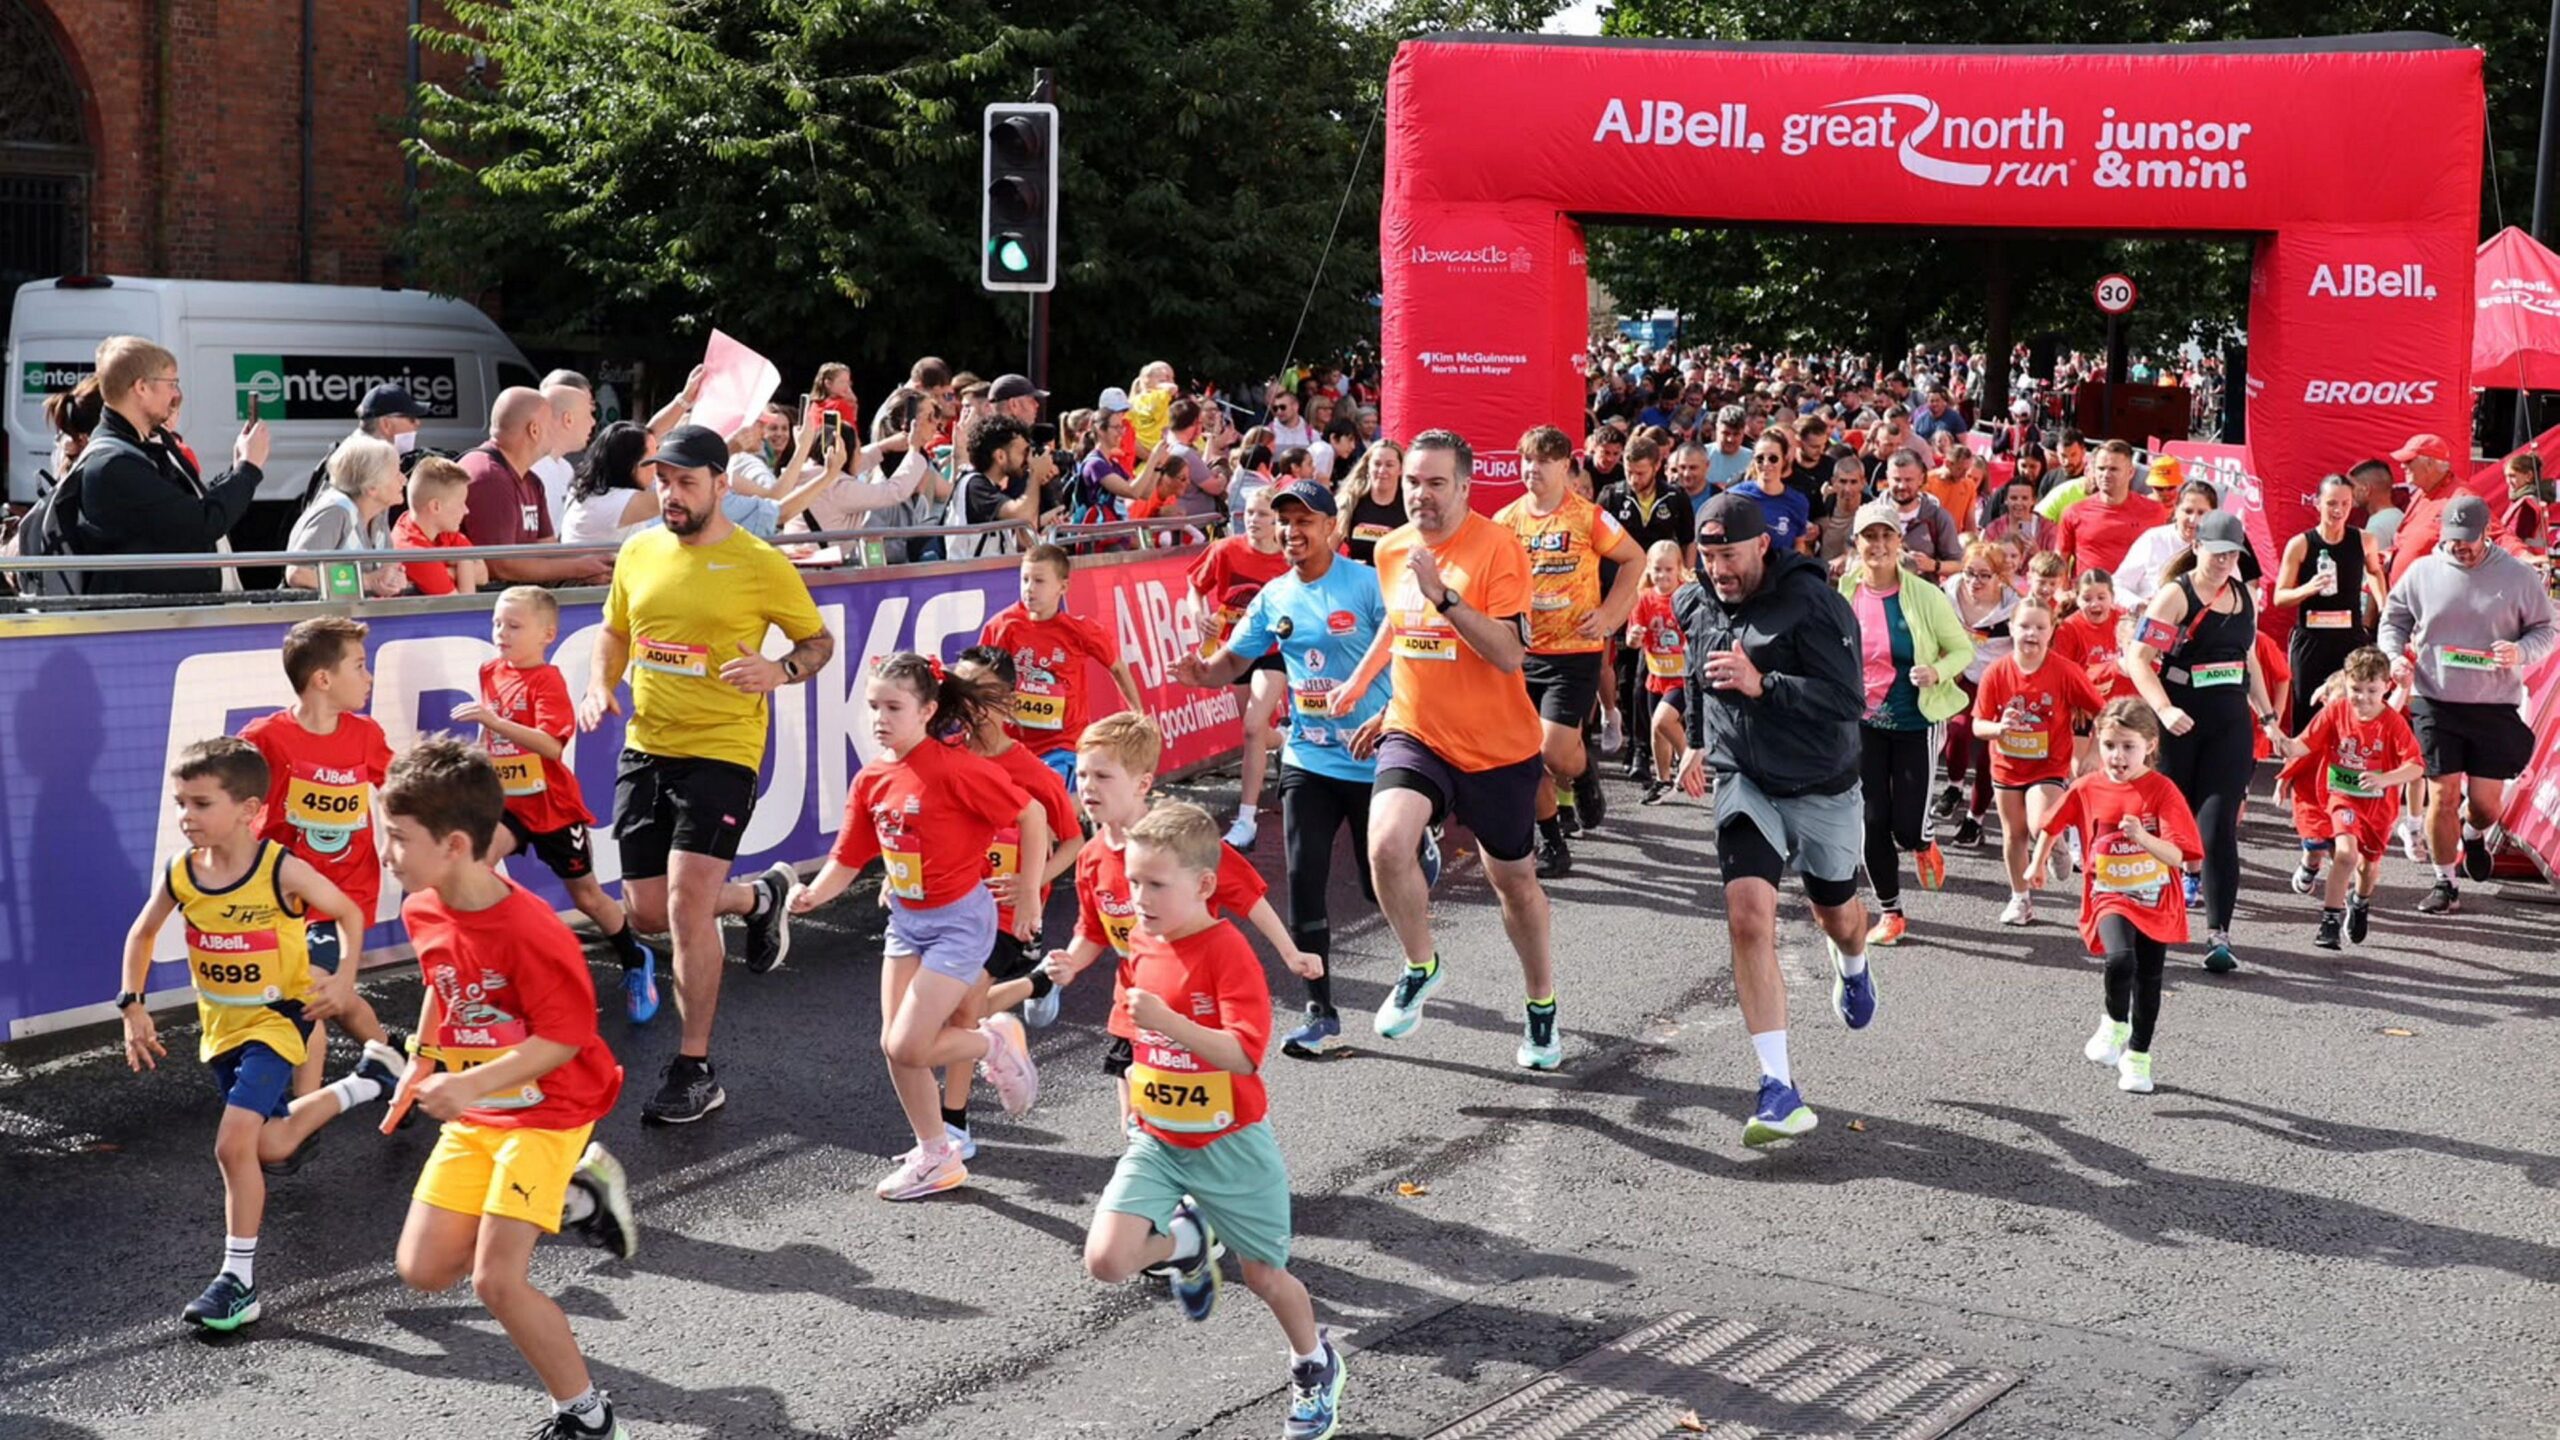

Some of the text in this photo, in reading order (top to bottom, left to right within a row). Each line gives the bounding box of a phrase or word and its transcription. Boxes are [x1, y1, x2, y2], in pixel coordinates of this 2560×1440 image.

[1780, 106, 2064, 156] great north
[2094, 107, 2252, 150] junior
[1993, 160, 2069, 188] run
[1411, 245, 1508, 263] Newcastle
[2100, 285, 2129, 302] 30
[1431, 352, 1527, 363] Kim McGuinness
[1431, 365, 1512, 376] North East Mayor
[2304, 379, 2438, 405] BROOKS
[1405, 639, 1440, 650] ADULT
[646, 650, 688, 665] ADULT
[2453, 653, 2486, 664] ADULT
[2206, 669, 2238, 679] ADULT
[1160, 691, 1197, 750] good
[302, 792, 359, 813] 4506
[2106, 860, 2156, 878] 4909
[199, 961, 261, 984] 4698
[1144, 1081, 1209, 1107] 4574
